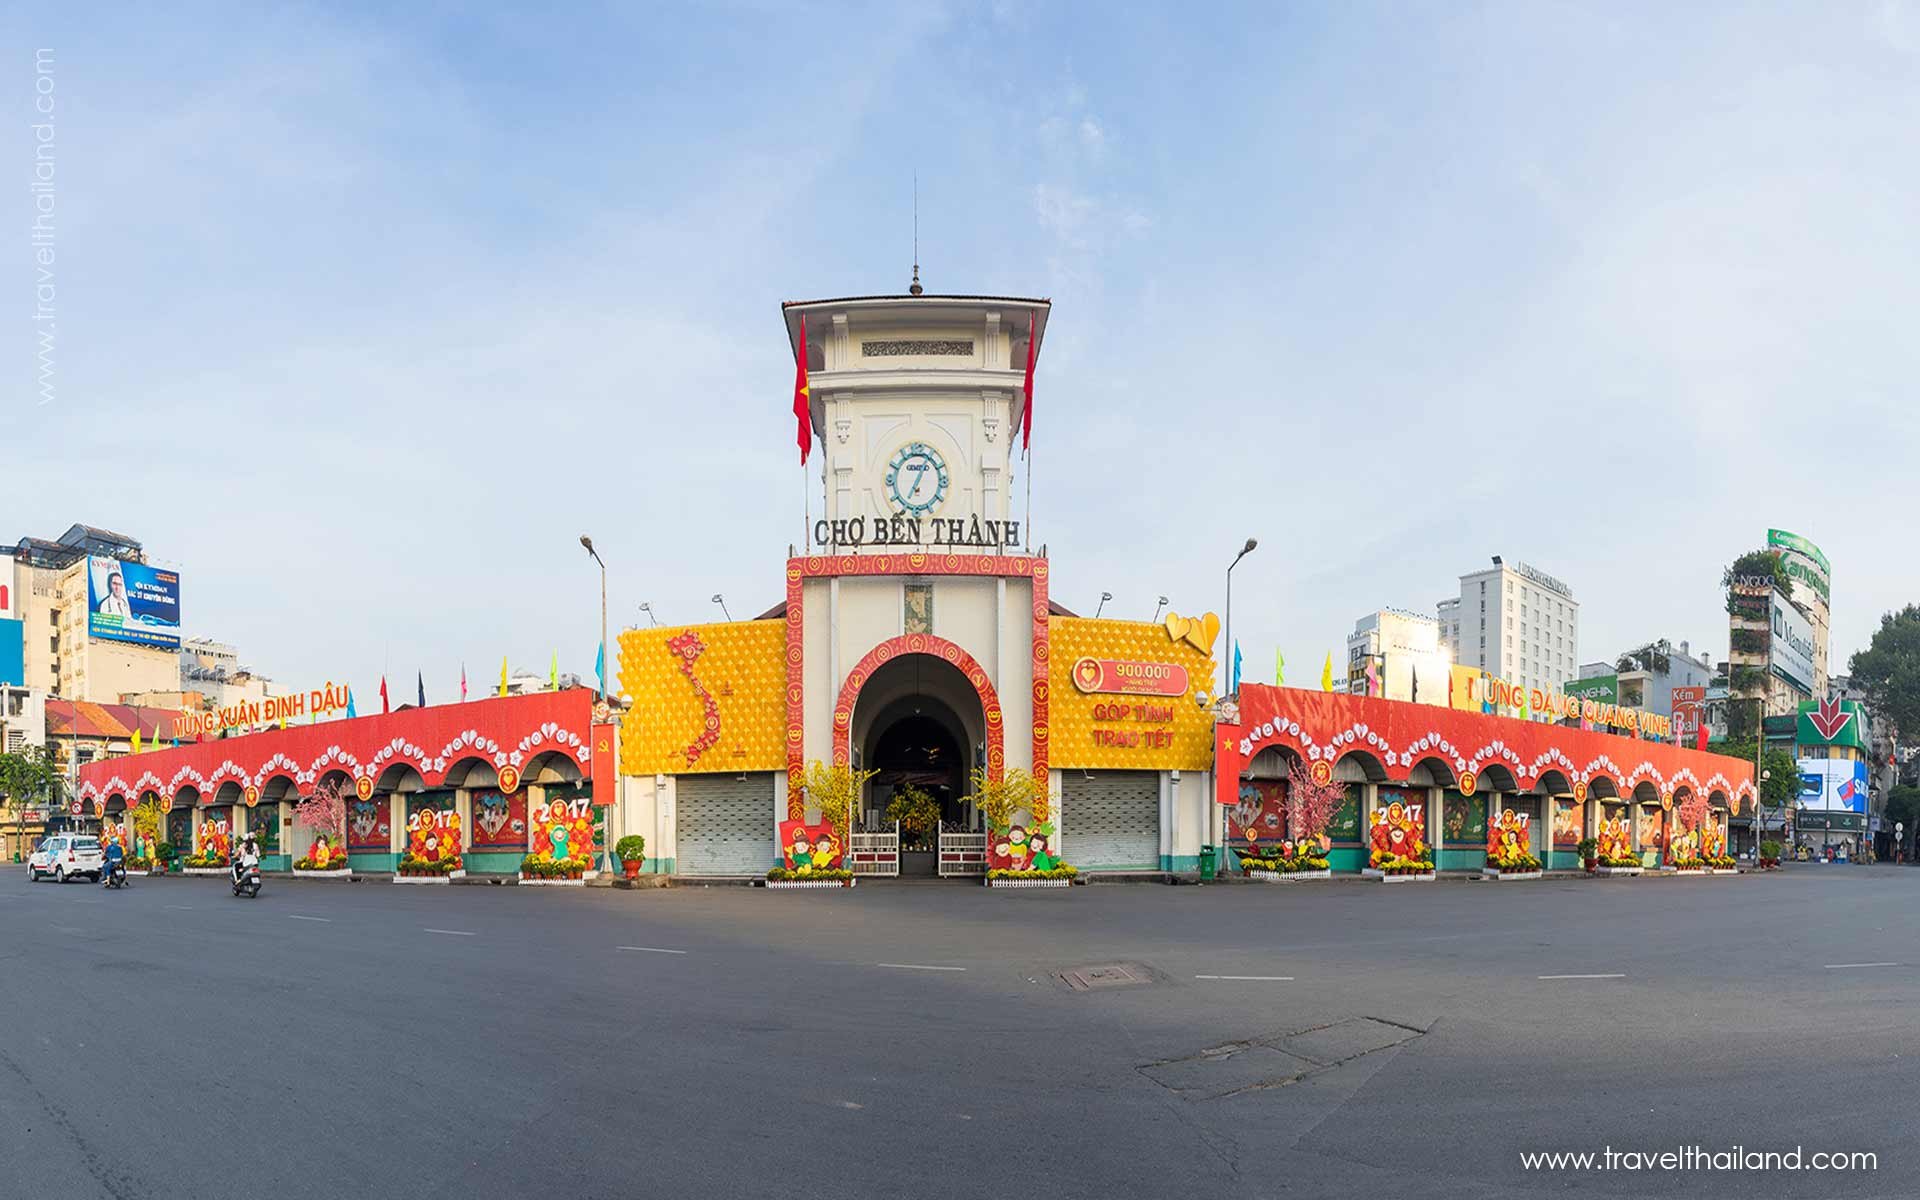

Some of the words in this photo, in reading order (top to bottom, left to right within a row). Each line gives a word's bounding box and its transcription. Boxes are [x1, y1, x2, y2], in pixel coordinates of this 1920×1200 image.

[815, 515, 864, 547] CHỢ
[873, 510, 922, 545] BẾN
[931, 513, 1020, 546] THÀNH
[1116, 664, 1170, 679] 900.000
[218, 699, 260, 730] XUÂN
[265, 693, 304, 722] ĐINH
[311, 681, 348, 717] DẬU
[1094, 700, 1130, 721] GÓP
[1135, 702, 1173, 722] TÌNH
[1531, 681, 1580, 719] ĐẢNG
[1583, 699, 1637, 730] QUANG
[1639, 710, 1670, 737] VINH
[1094, 730, 1139, 747] TRAO
[1145, 727, 1174, 748] TẾT
